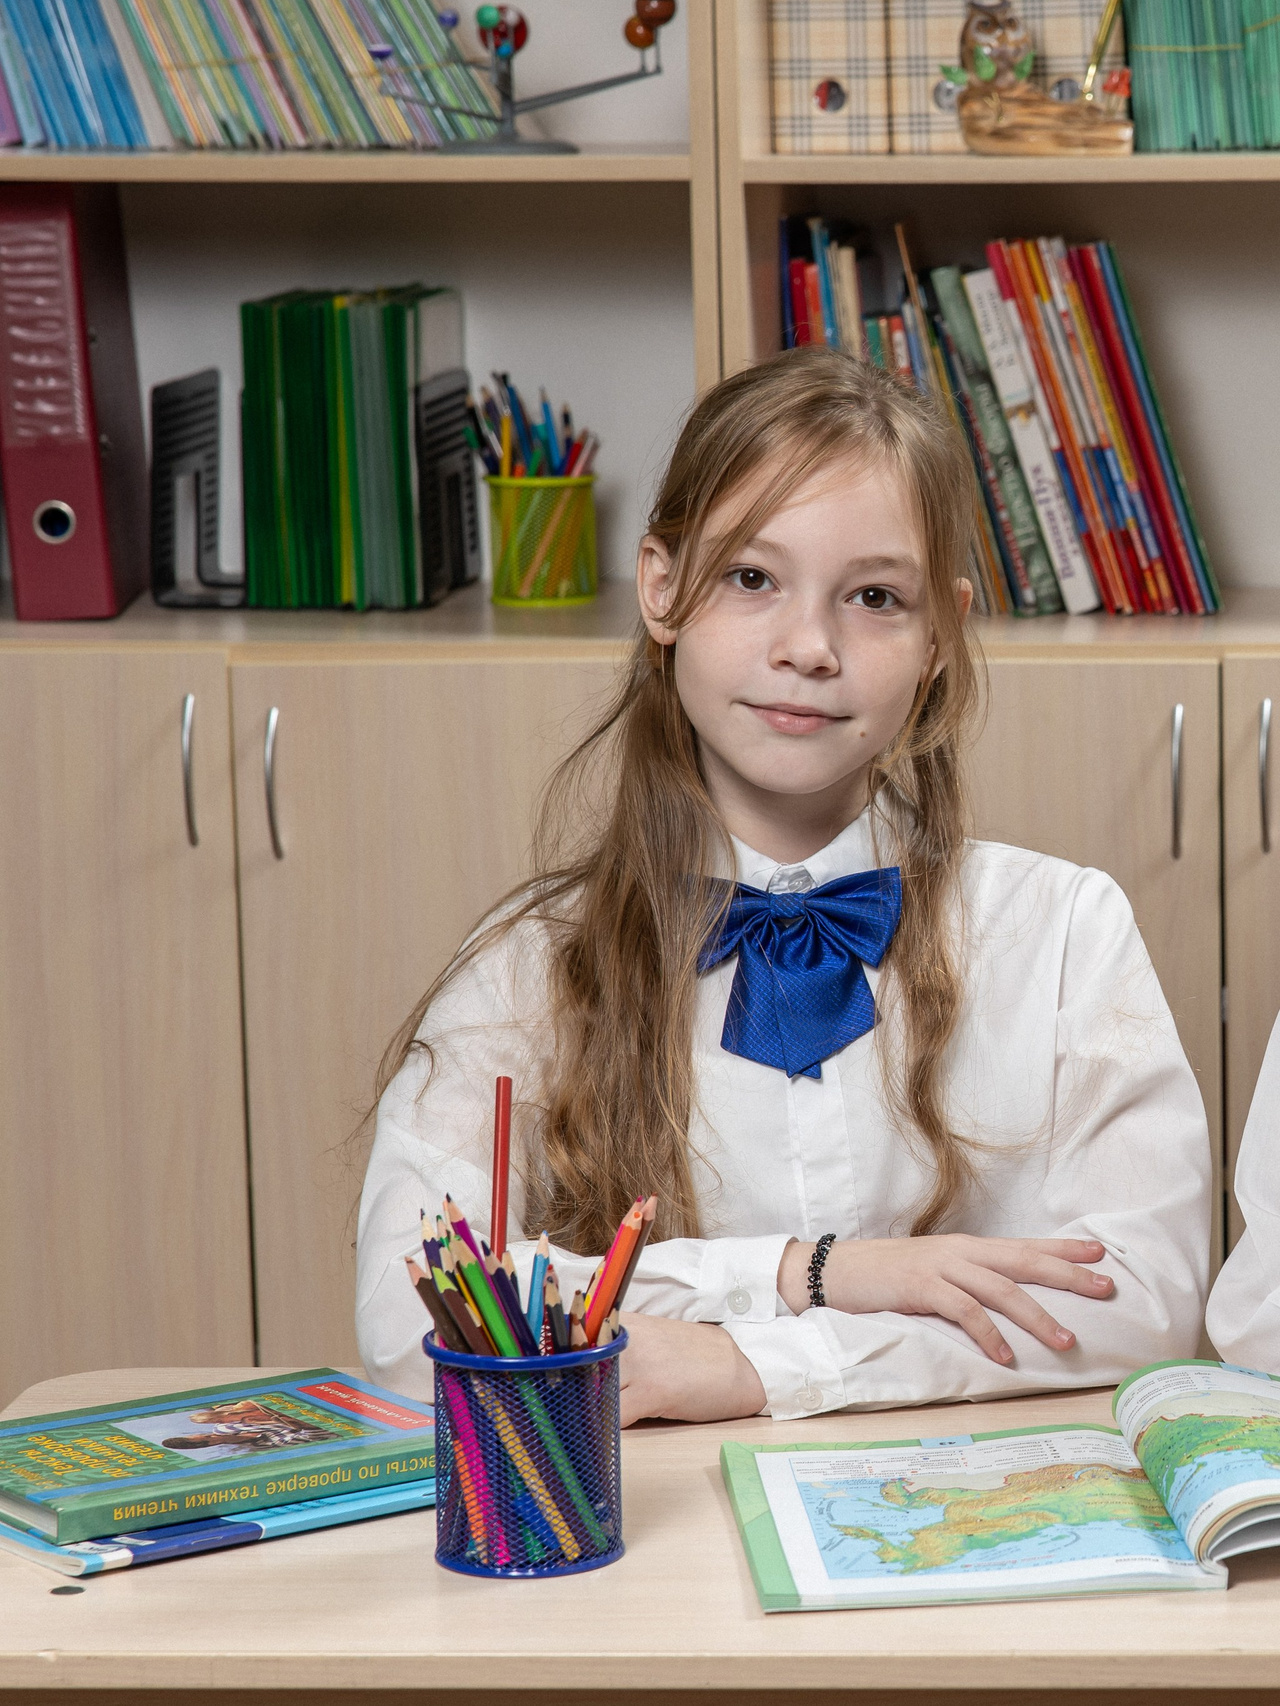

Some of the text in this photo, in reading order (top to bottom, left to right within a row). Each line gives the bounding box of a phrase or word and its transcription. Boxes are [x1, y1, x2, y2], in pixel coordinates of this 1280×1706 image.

[27, 1435, 134, 1478] по проверке
[71, 1437, 145, 1467] техники
[104, 1435, 166, 1460] чтения
[18, 1448, 82, 1476] Тексты
[359, 1464, 379, 1480] по
[386, 1454, 437, 1476] ексты
[266, 1468, 352, 1496] проверке
[113, 1498, 178, 1521] чтения
[184, 1485, 259, 1509] техники
